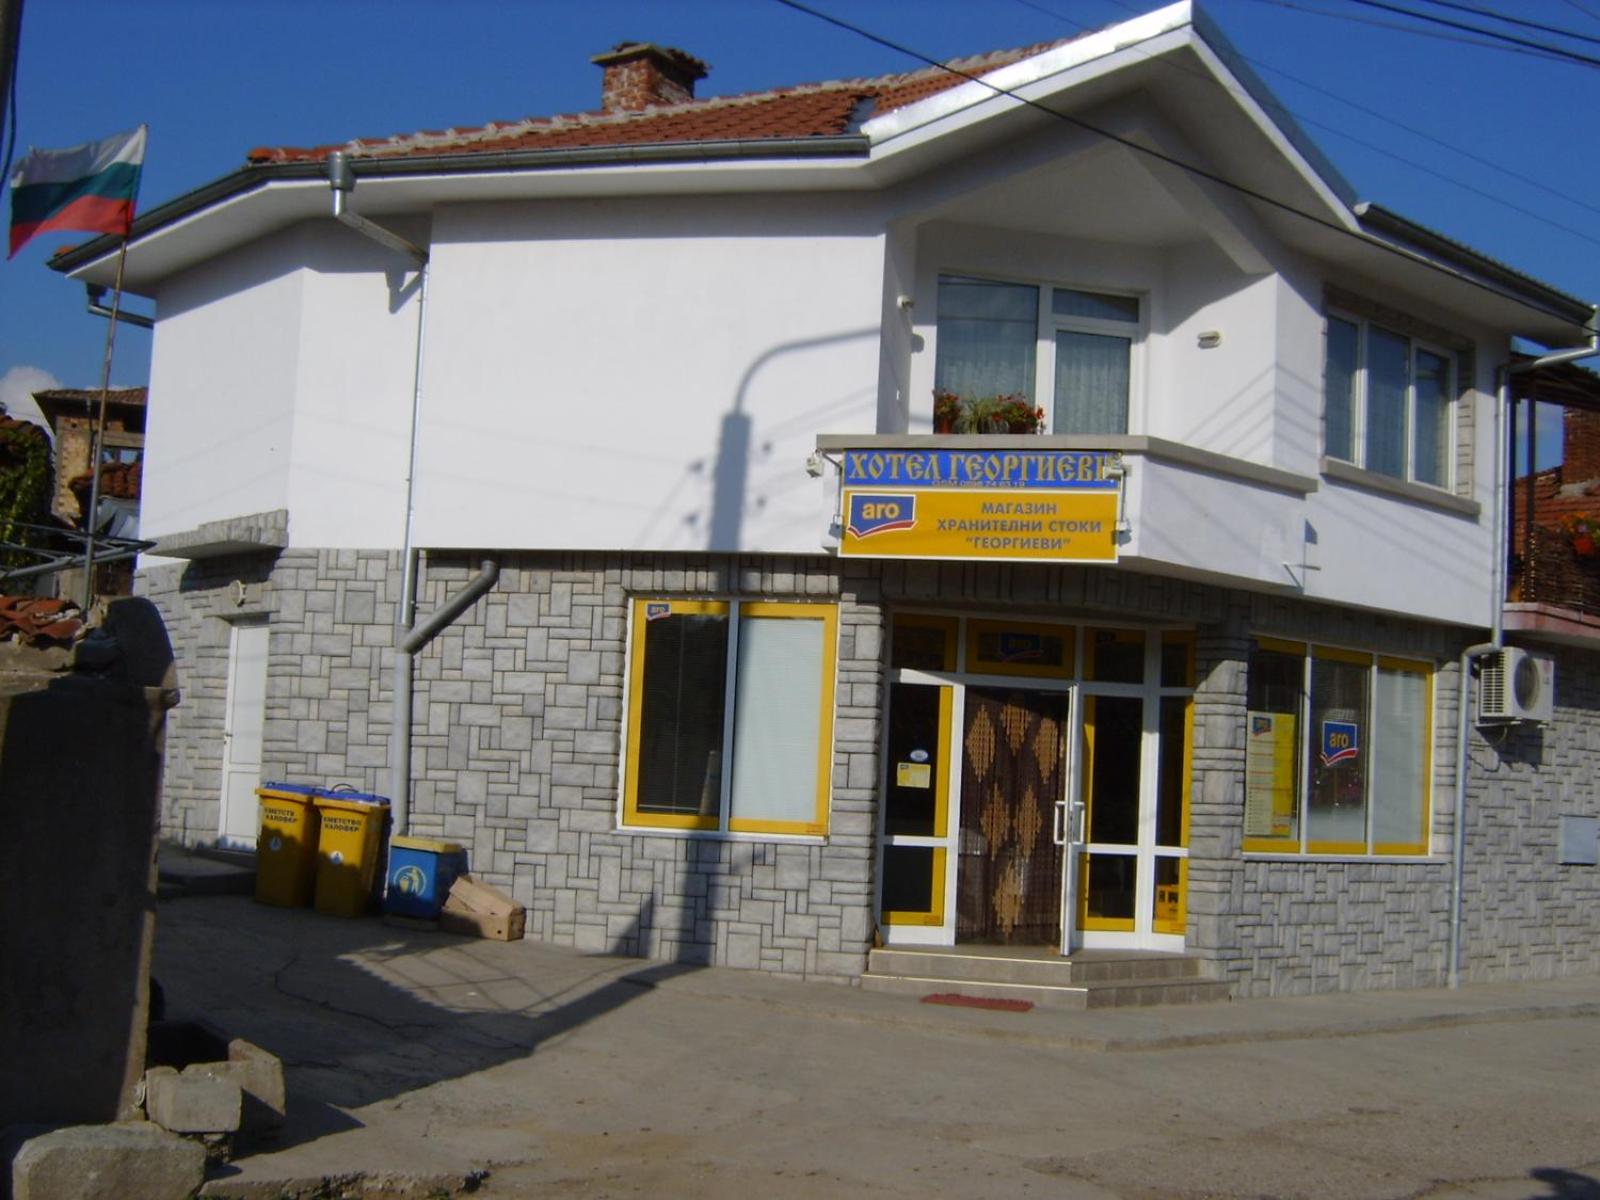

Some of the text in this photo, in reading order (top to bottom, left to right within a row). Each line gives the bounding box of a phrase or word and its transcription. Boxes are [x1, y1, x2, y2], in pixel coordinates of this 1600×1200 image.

[849, 453, 941, 480] ХОТЕЛ
[862, 502, 900, 520] aro
[981, 502, 1057, 515] МАГАЗИН
[937, 518, 1102, 533] ХРАНИТЕЛНИ СТОКИ
[1329, 732, 1349, 748] aro
